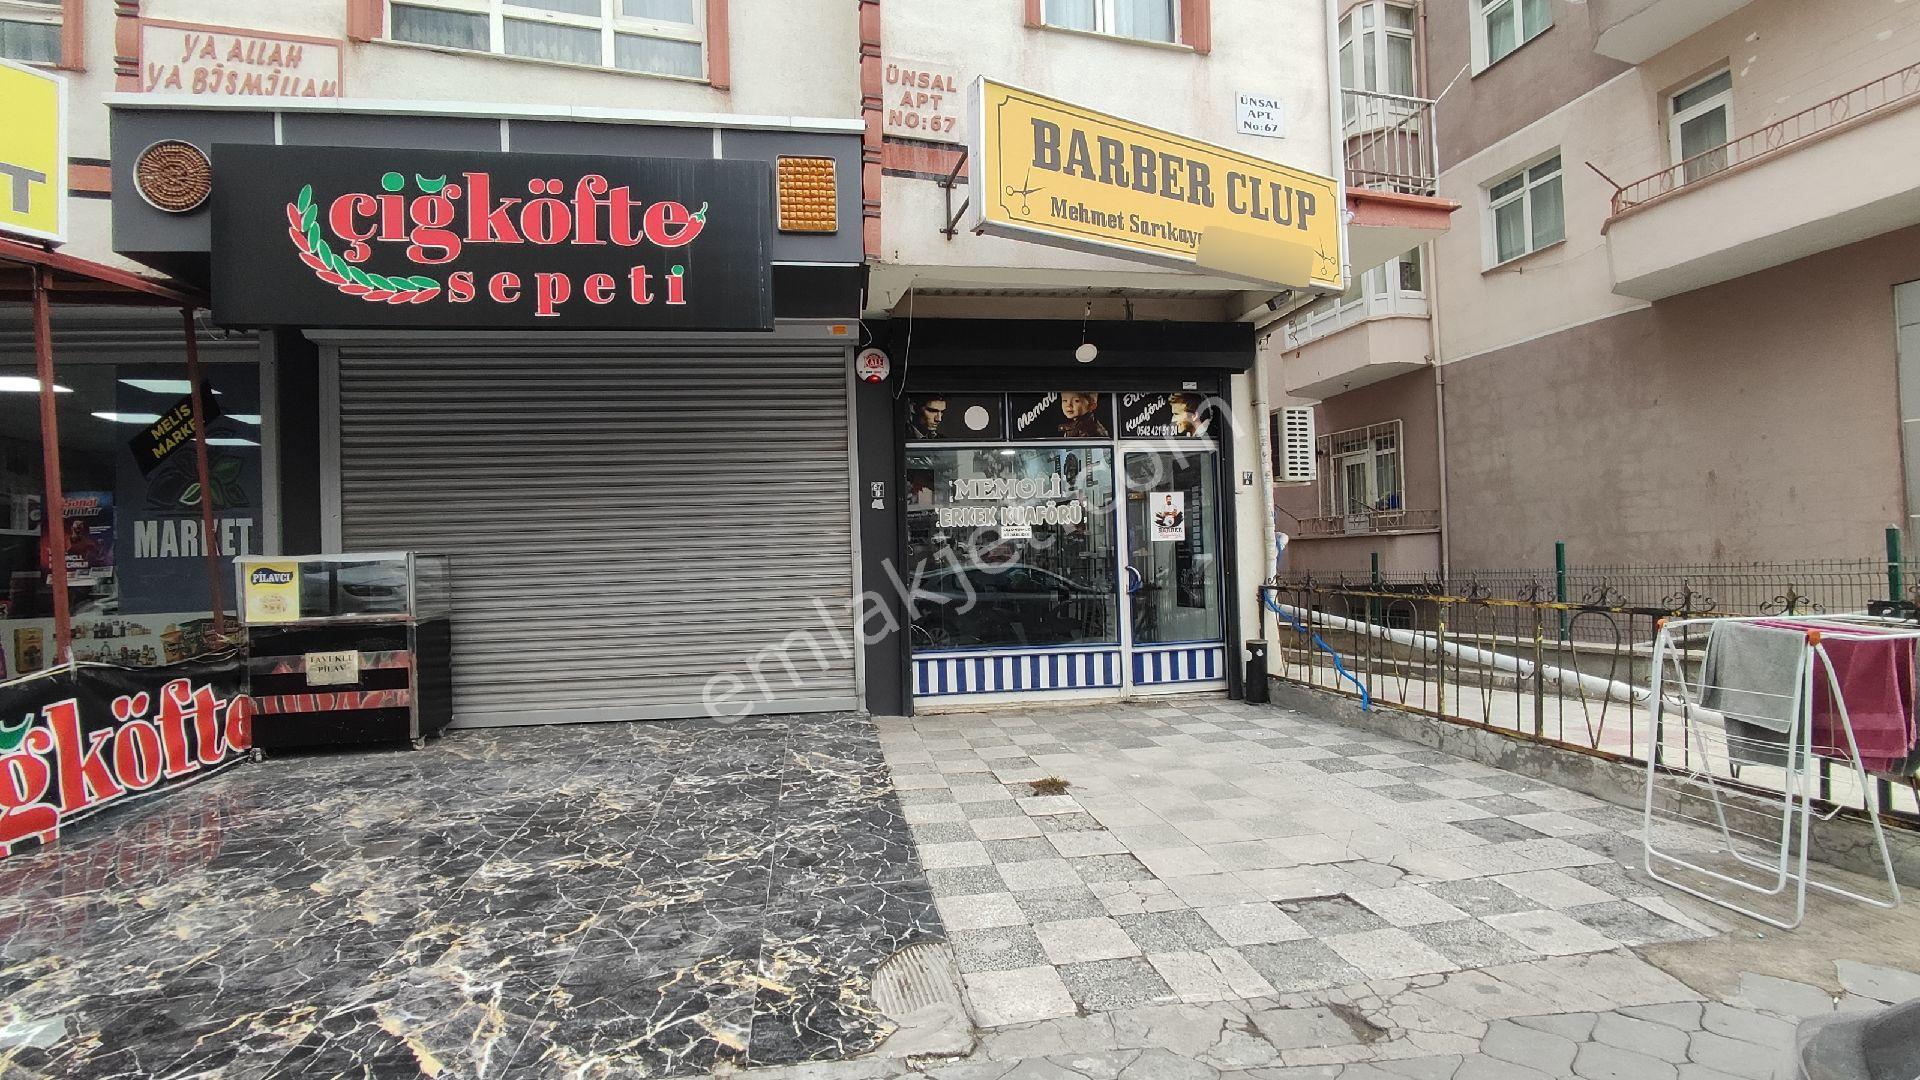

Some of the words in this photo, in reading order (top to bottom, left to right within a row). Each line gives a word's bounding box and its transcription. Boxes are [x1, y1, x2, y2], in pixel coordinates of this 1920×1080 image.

[182, 34, 217, 63] YA
[227, 38, 303, 69] ALLAH
[146, 62, 182, 92] YA
[886, 64, 957, 93] ÜNSAL
[900, 90, 942, 111] APT
[1240, 94, 1281, 110] ÜNSAL
[1248, 110, 1274, 121] APT.
[888, 109, 957, 133] NO:67
[1031, 117, 1215, 209] BARBER
[1226, 171, 1316, 231] CLUP
[328, 171, 708, 265] çiğköfte
[1050, 196, 1125, 231] Mehmet
[448, 264, 687, 317] sepeti
[151, 404, 191, 441] MELİS
[152, 418, 205, 459] MARKE
[939, 505, 998, 528] ERKEK
[1000, 500, 1083, 527] KUAFÖRÜ
[252, 570, 290, 583] PİLAVCI
